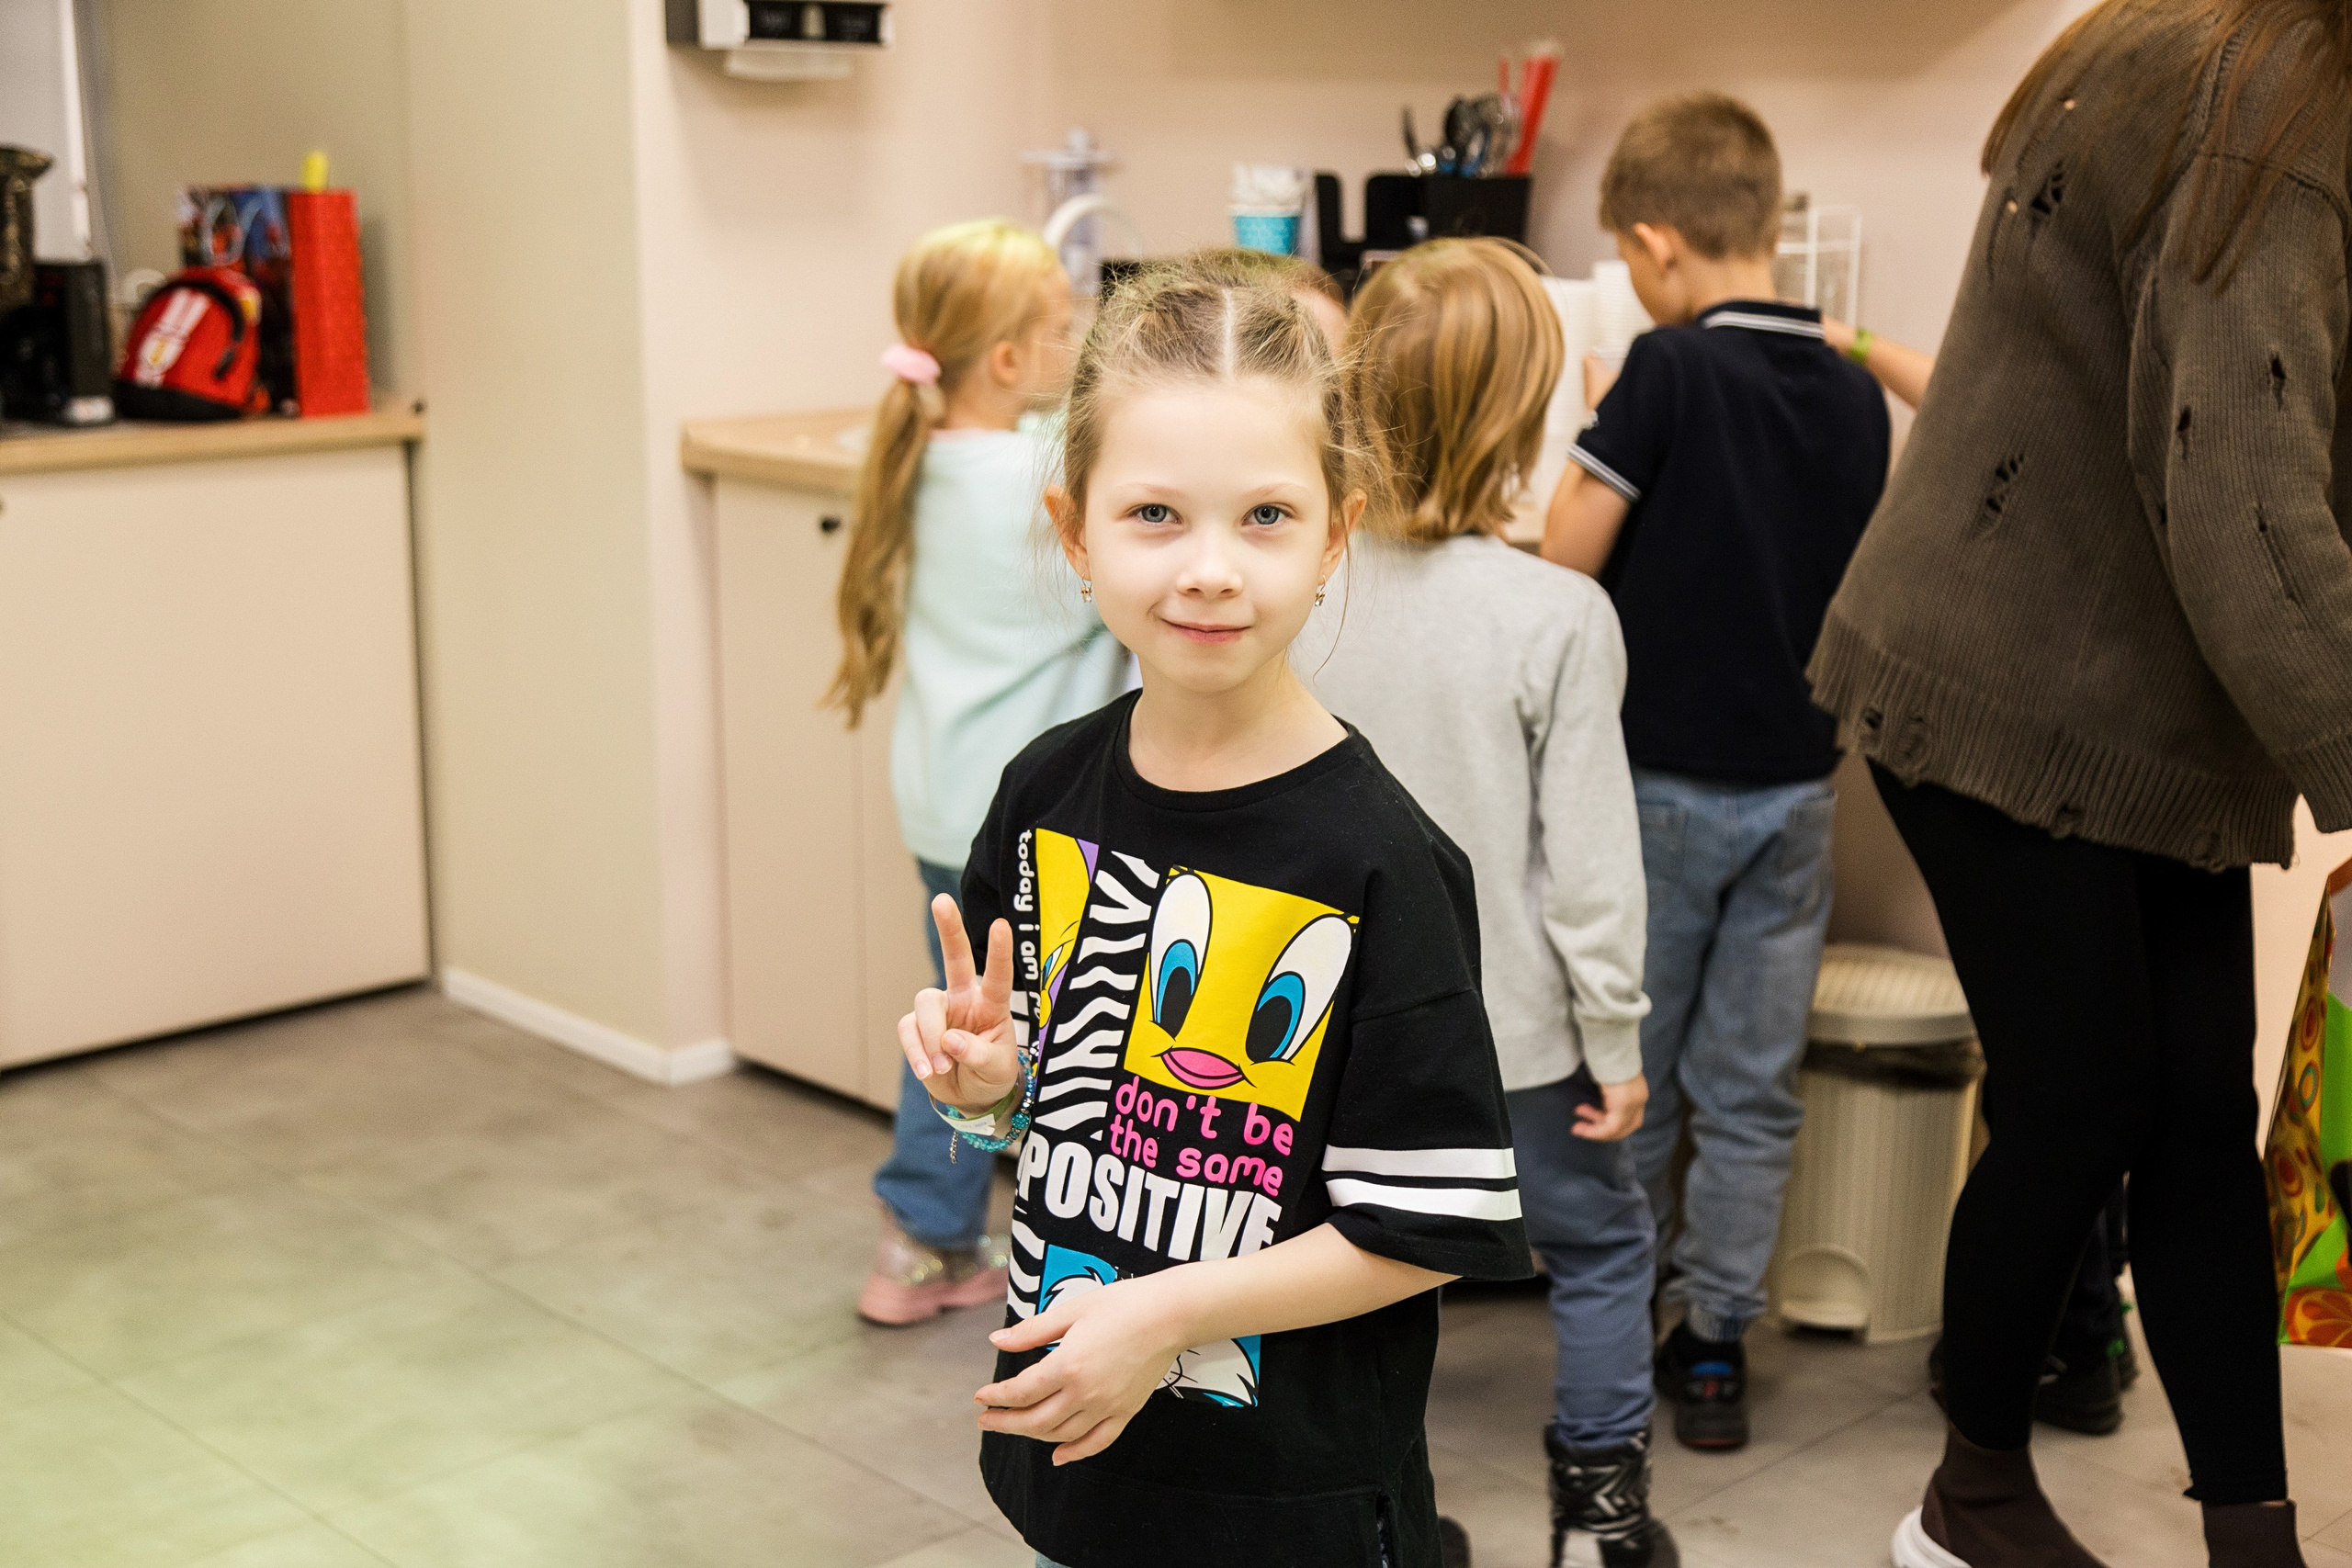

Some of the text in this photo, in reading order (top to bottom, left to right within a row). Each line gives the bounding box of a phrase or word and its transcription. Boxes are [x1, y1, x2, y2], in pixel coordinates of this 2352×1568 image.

[1013, 829, 1035, 911] today
[1021, 941, 1039, 980] am
[1110, 1114, 1283, 1197] the same
[1115, 1076, 1294, 1156] don't be
